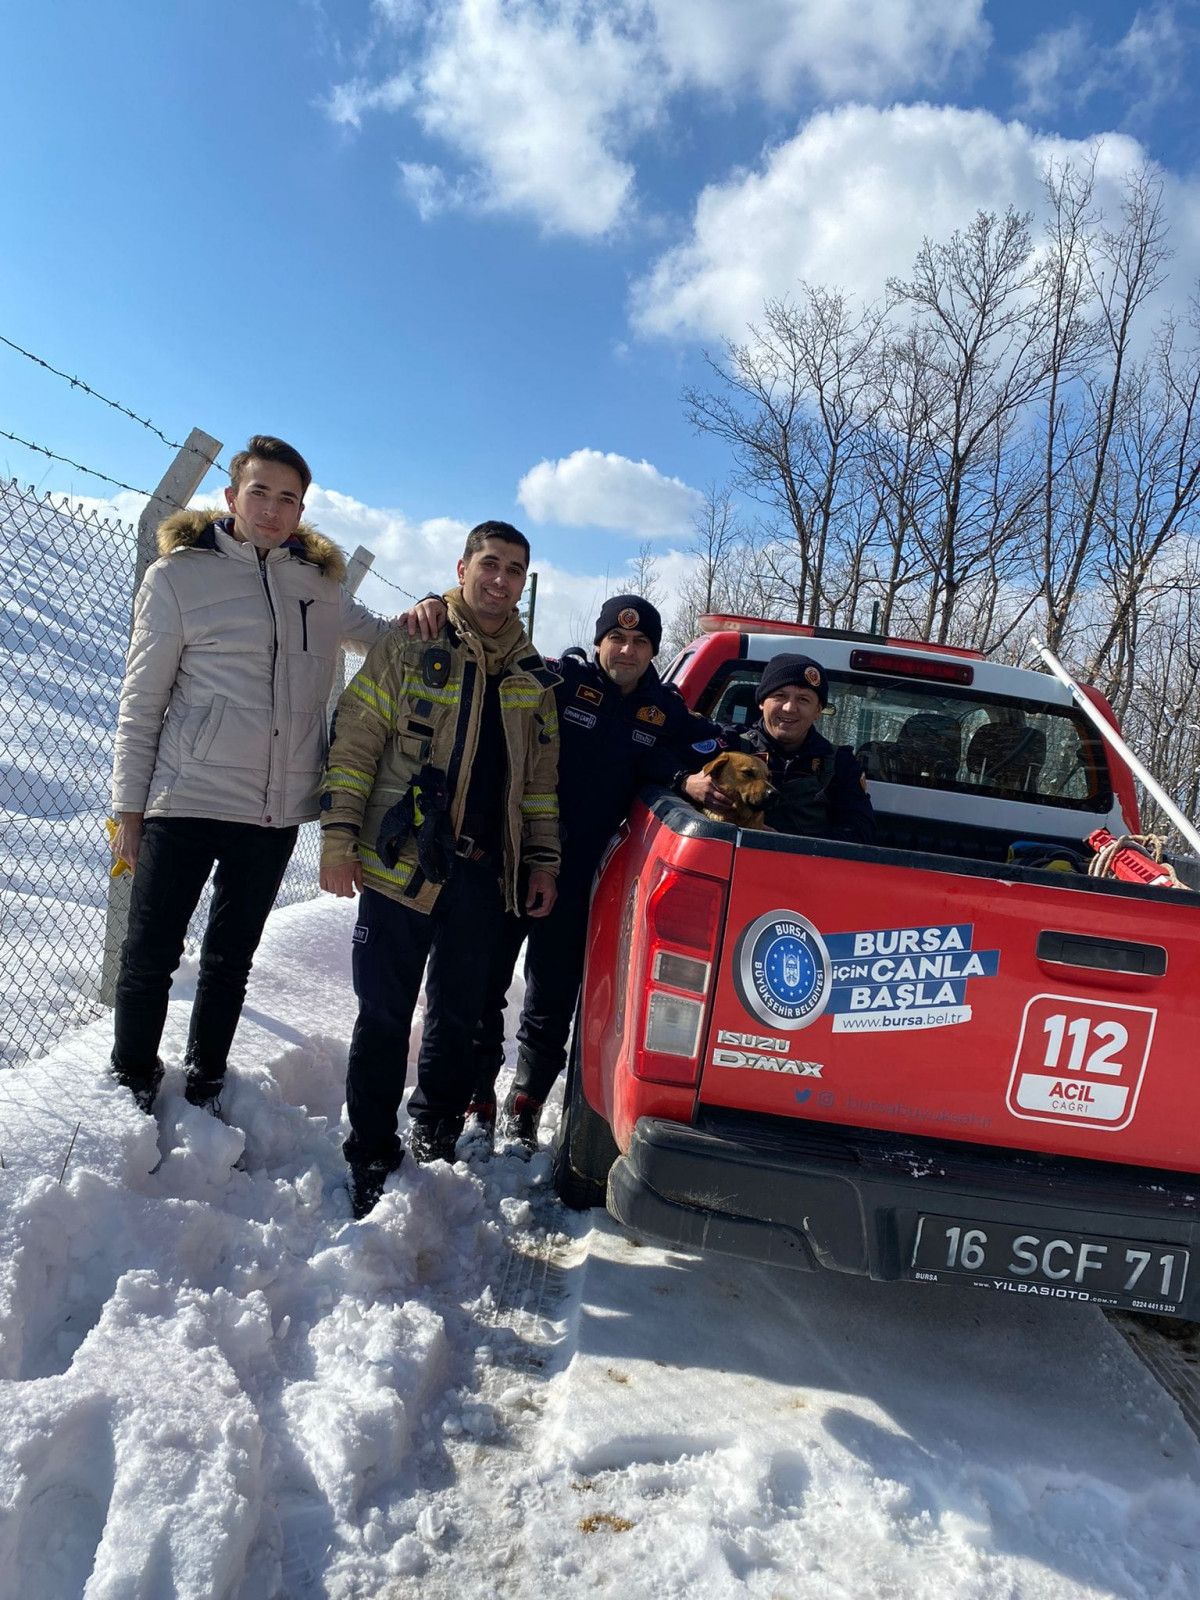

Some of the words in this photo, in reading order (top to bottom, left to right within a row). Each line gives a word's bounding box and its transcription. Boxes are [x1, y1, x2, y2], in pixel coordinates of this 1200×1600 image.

[775, 924, 807, 942] BURSA
[852, 927, 966, 957] BURSA
[870, 953, 985, 983] CANLA
[754, 961, 793, 1017] BÜYÜKŞEHİR
[849, 981, 957, 1010] BAŞLA
[842, 1012, 963, 1029] www.bursa.bel.tr
[717, 1029, 791, 1053] ISUZU
[1043, 1013, 1130, 1077] 112
[1052, 1100, 1089, 1113] ÇAĞRI
[945, 1226, 988, 1270] 16
[1008, 1234, 1108, 1284] SCF
[1123, 1249, 1175, 1296] 71
[915, 1272, 938, 1282] BURSA
[1132, 1300, 1147, 1308] 0224
